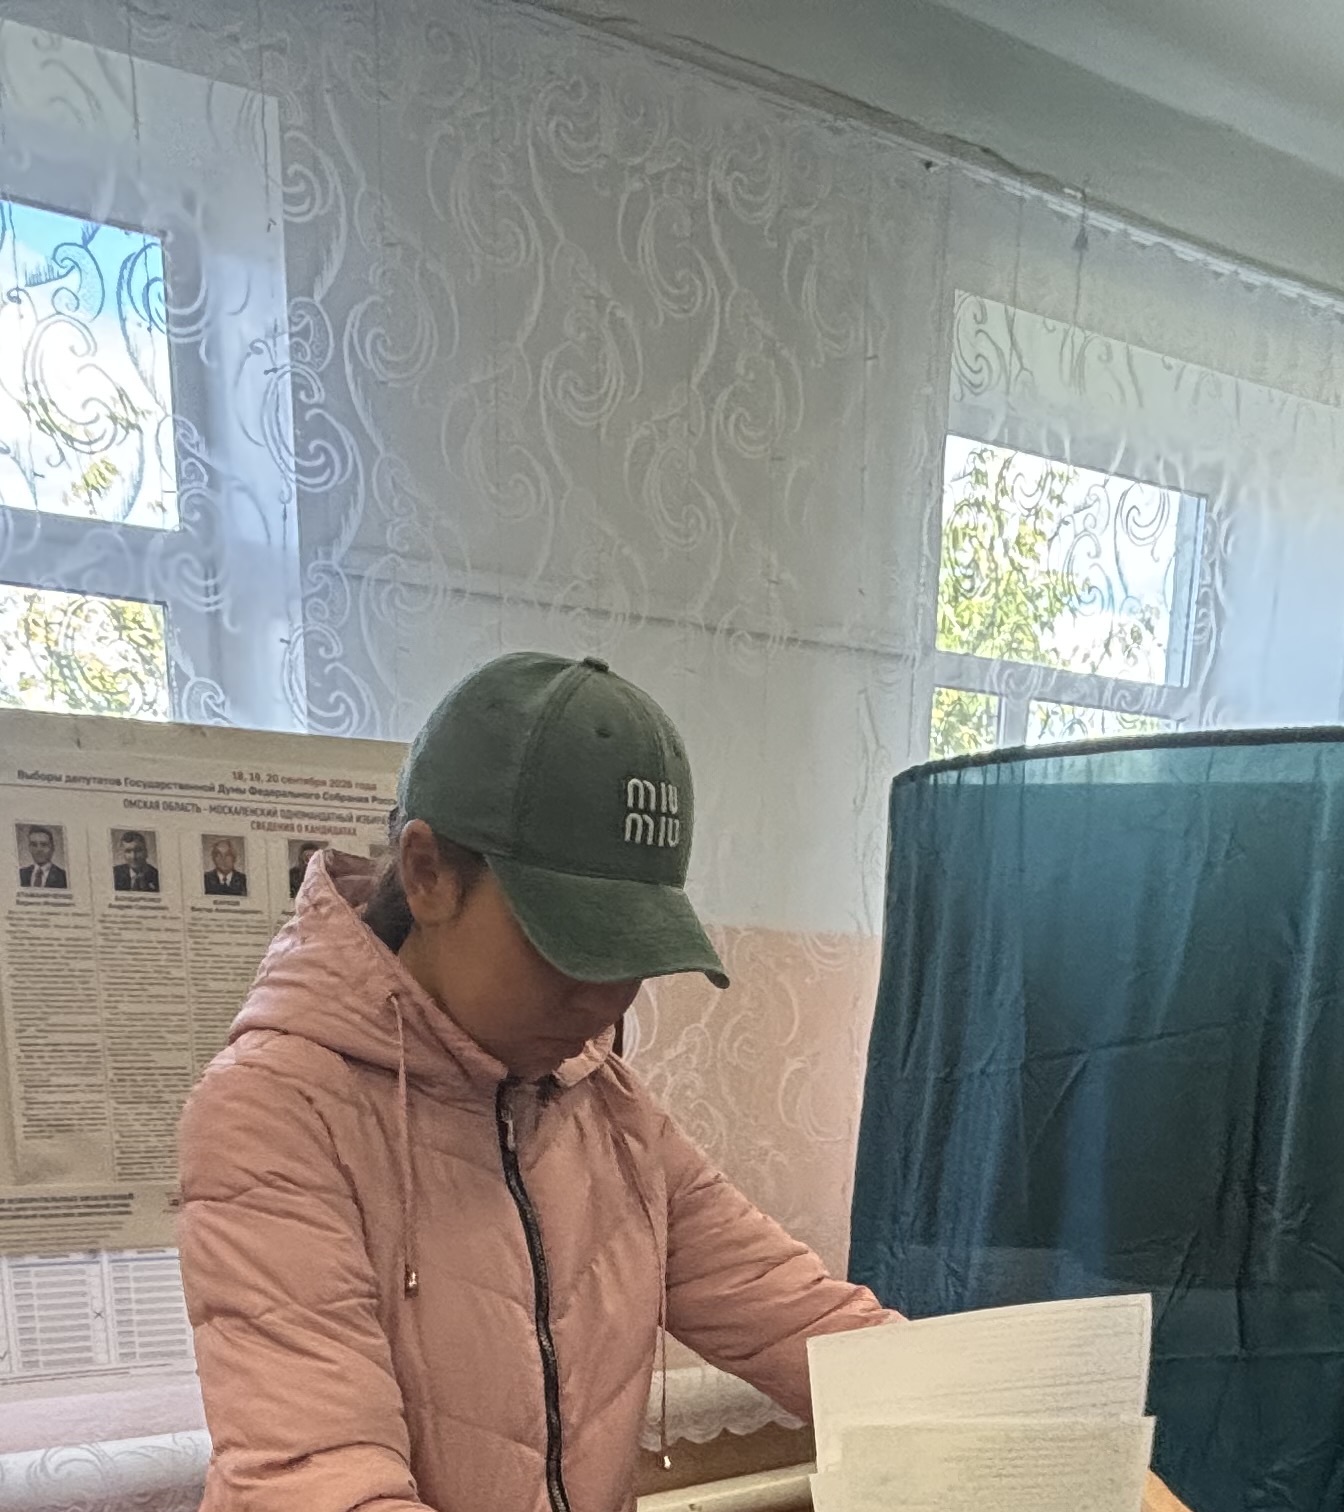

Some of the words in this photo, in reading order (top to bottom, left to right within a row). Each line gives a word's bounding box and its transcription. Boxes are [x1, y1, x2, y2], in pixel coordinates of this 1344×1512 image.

[17, 770, 62, 783] Выборы
[65, 774, 122, 787] депутатов
[124, 777, 215, 792] Государственной
[218, 784, 246, 796] Думы
[248, 786, 321, 801] Федерального
[322, 792, 369, 804] Собрания
[265, 773, 279, 783] 20
[280, 776, 327, 788] сентября
[354, 781, 377, 791] года
[123, 798, 160, 812] ОМСКАЯ
[162, 800, 202, 813] ОБЛАСТЬ
[209, 804, 278, 818] МОСКАЛЕНСКИЙ
[250, 820, 295, 833] СВЕДЕНИЯ
